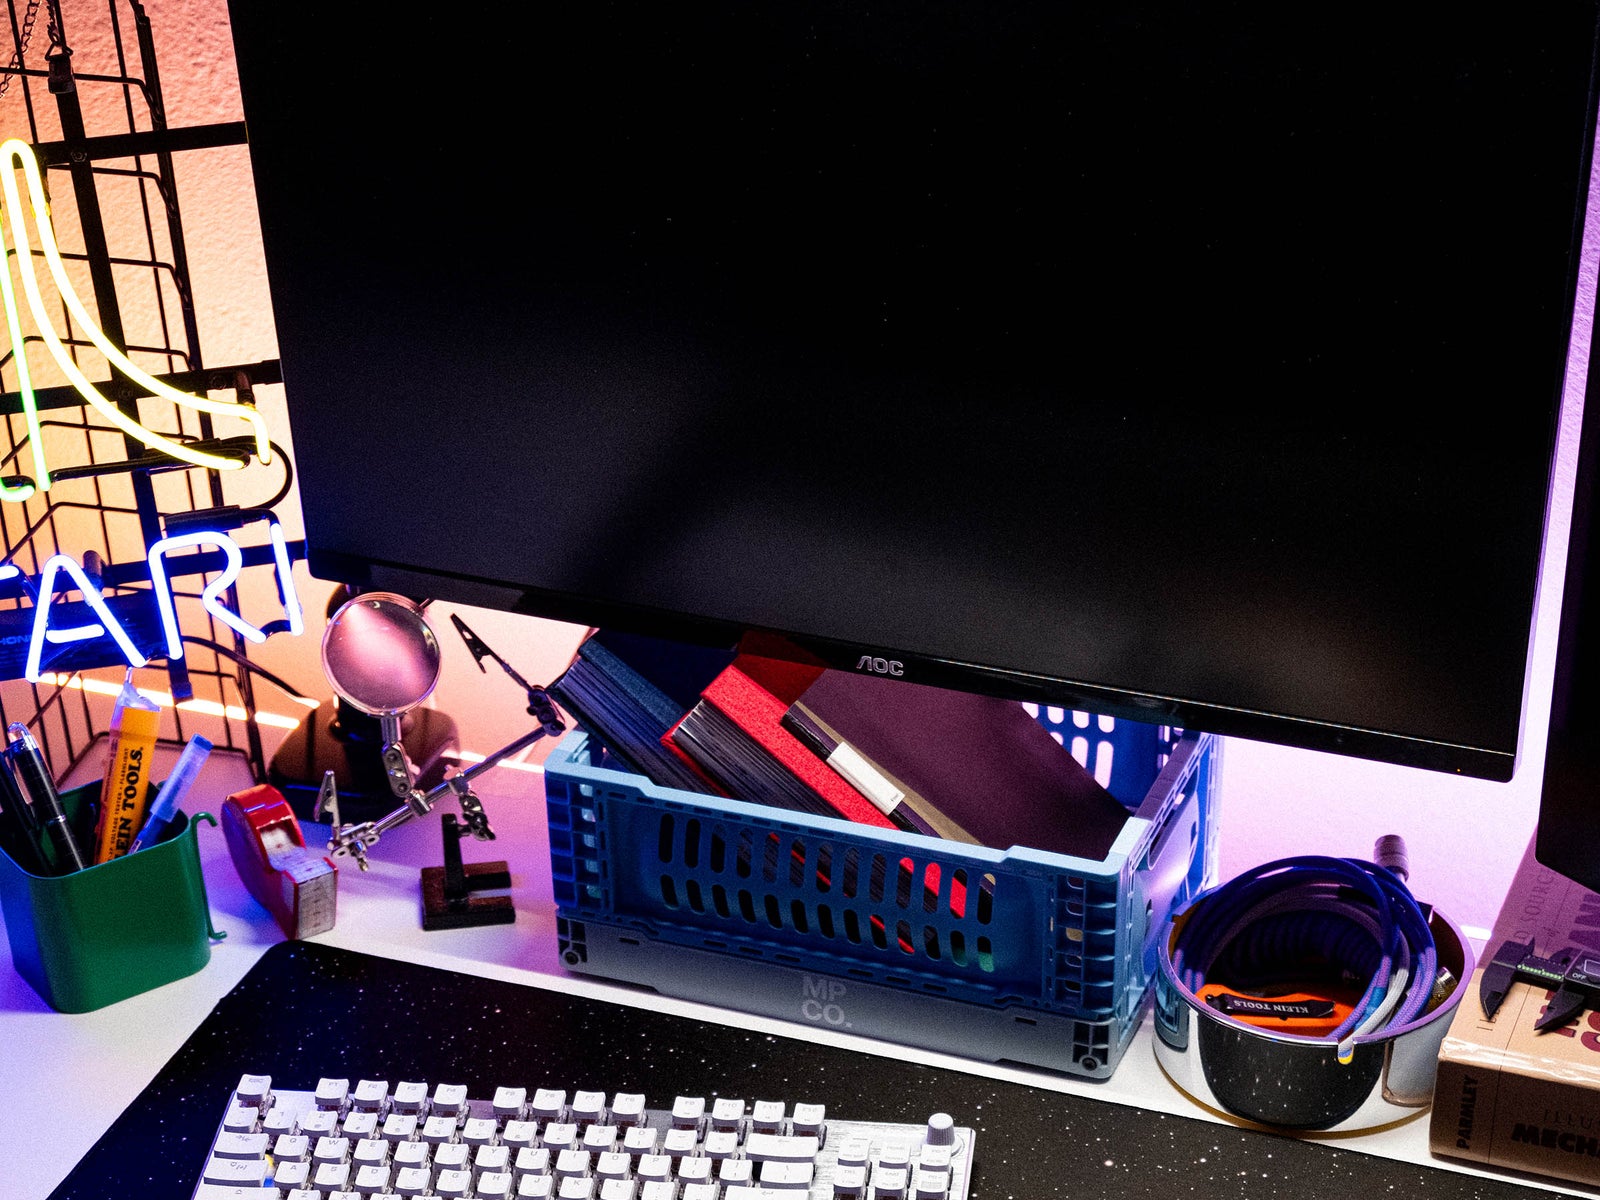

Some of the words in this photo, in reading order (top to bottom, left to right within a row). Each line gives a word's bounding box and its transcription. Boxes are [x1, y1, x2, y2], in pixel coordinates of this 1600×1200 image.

[0, 522, 305, 683] ARI
[802, 976, 848, 1002] MP
[1572, 972, 1587, 981] OFF
[801, 999, 853, 1028] CO.
[1233, 1000, 1271, 1011] TOOLS
[1273, 1004, 1309, 1014] KLEIN
[1456, 1074, 1478, 1150] PARMLEY
[1511, 1122, 1600, 1159] MECH
